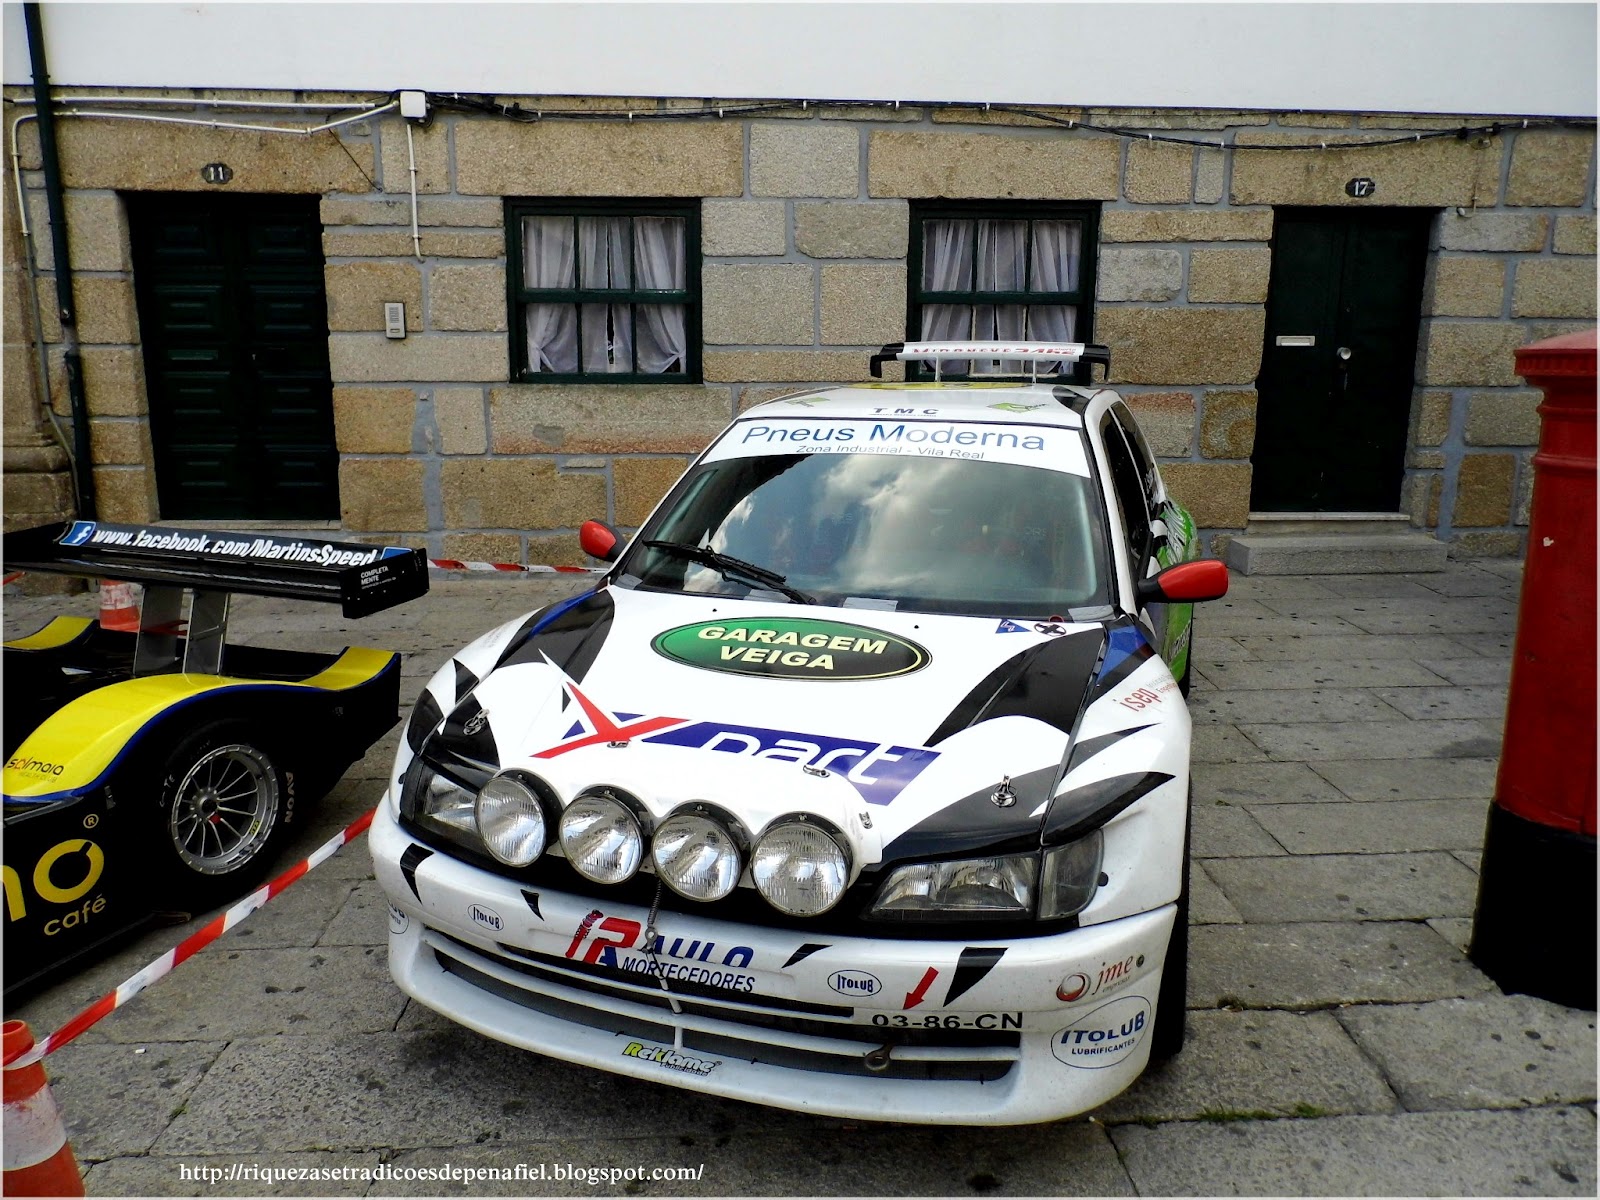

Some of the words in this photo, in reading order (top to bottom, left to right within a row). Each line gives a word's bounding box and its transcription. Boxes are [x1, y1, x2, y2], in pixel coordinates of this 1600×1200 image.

[210, 166, 224, 180] 11
[1354, 181, 1369, 196] 17
[742, 426, 856, 444] Pneus
[869, 424, 1045, 451] Moderna
[796, 445, 831, 453] Zona
[837, 445, 903, 454] Industrial
[918, 447, 945, 456] Vila
[951, 449, 985, 459] Real
[91, 529, 378, 567] www.facebook.com/MartinsSpeed
[360, 565, 389, 579] COMPLETA
[360, 575, 380, 586] MENTE
[697, 626, 889, 655] GARAGEM
[719, 645, 836, 671] VEIGA
[285, 771, 295, 823] AVON
[44, 893, 107, 936] café
[472, 906, 500, 930] ITOLUB
[837, 974, 874, 993] ITOLUB
[1091, 955, 1134, 996] jme
[871, 1012, 1023, 1030] 03-86-CN
[1060, 1010, 1145, 1045] ITOLUB
[1071, 1037, 1136, 1056] LUBRIFICANTES
